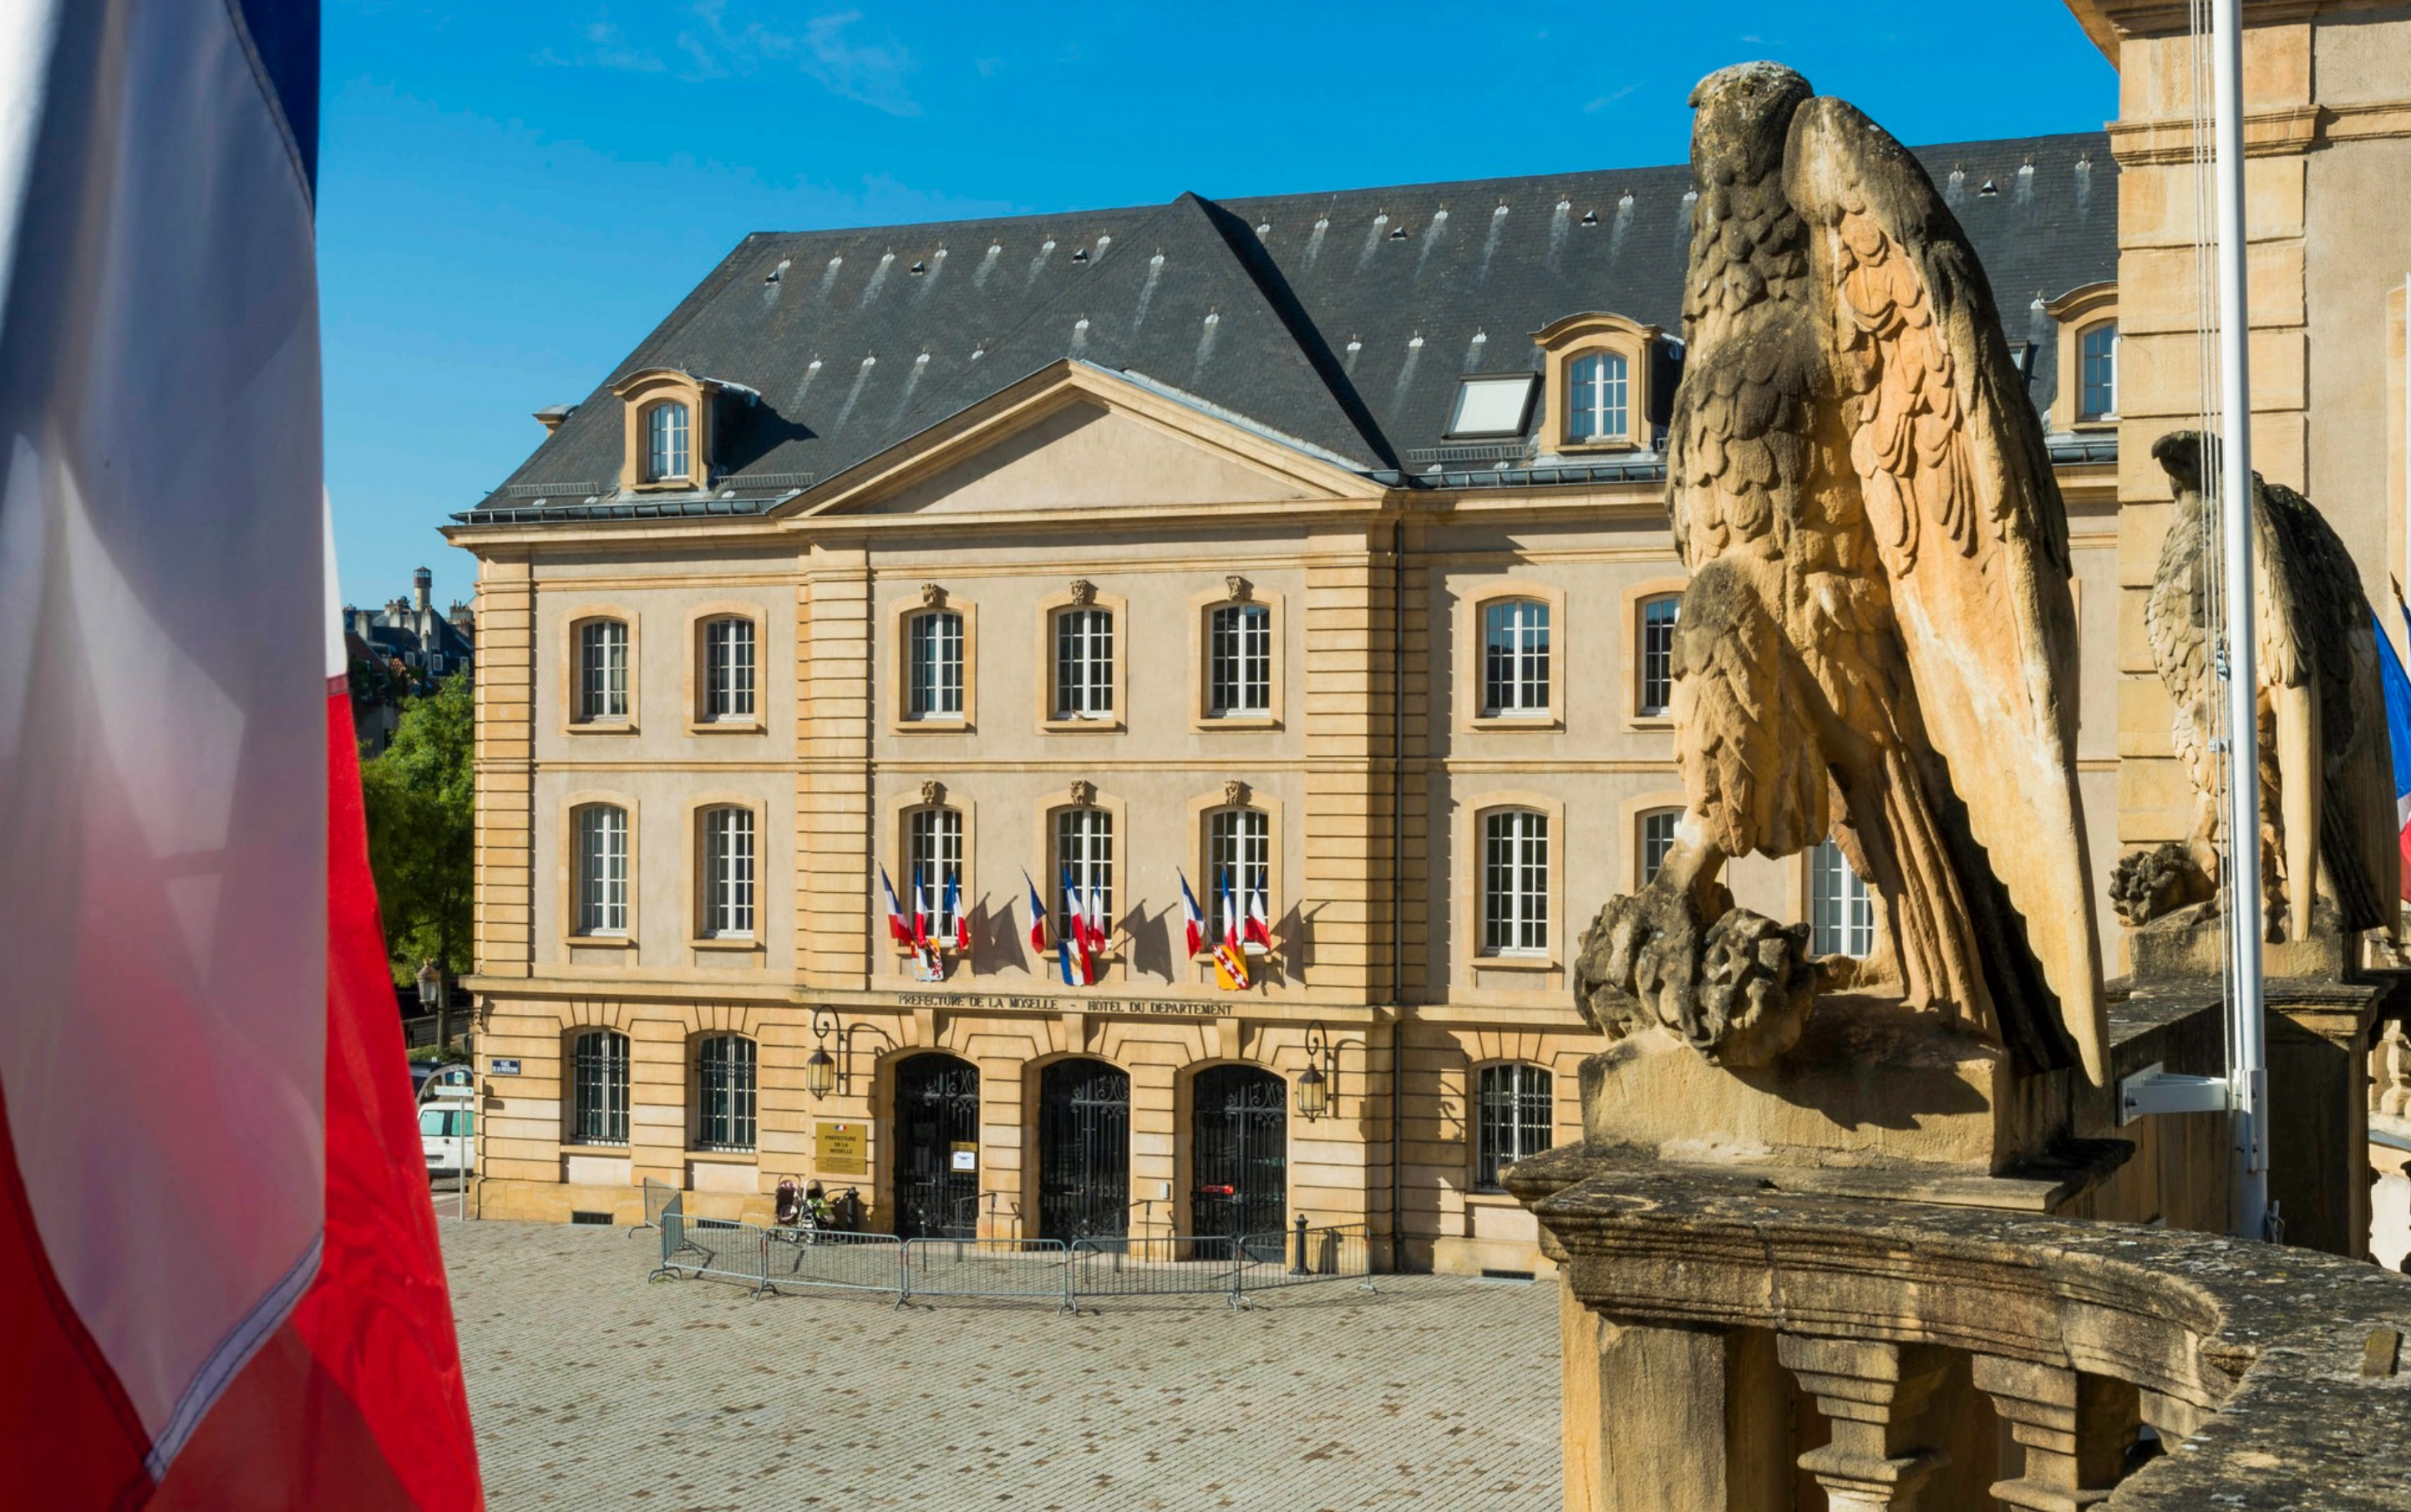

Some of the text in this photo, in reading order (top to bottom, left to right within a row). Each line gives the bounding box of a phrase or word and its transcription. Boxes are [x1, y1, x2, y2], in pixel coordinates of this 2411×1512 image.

[899, 994, 965, 1007] PREFECTURE
[969, 997, 984, 1007] DE
[988, 997, 1004, 1008] LA
[1009, 997, 1059, 1010] MOSELLE
[1088, 1001, 1124, 1012] HOTEL
[1129, 1002, 1145, 1012] DU
[1150, 1002, 1233, 1015] DEPARTEMENT
